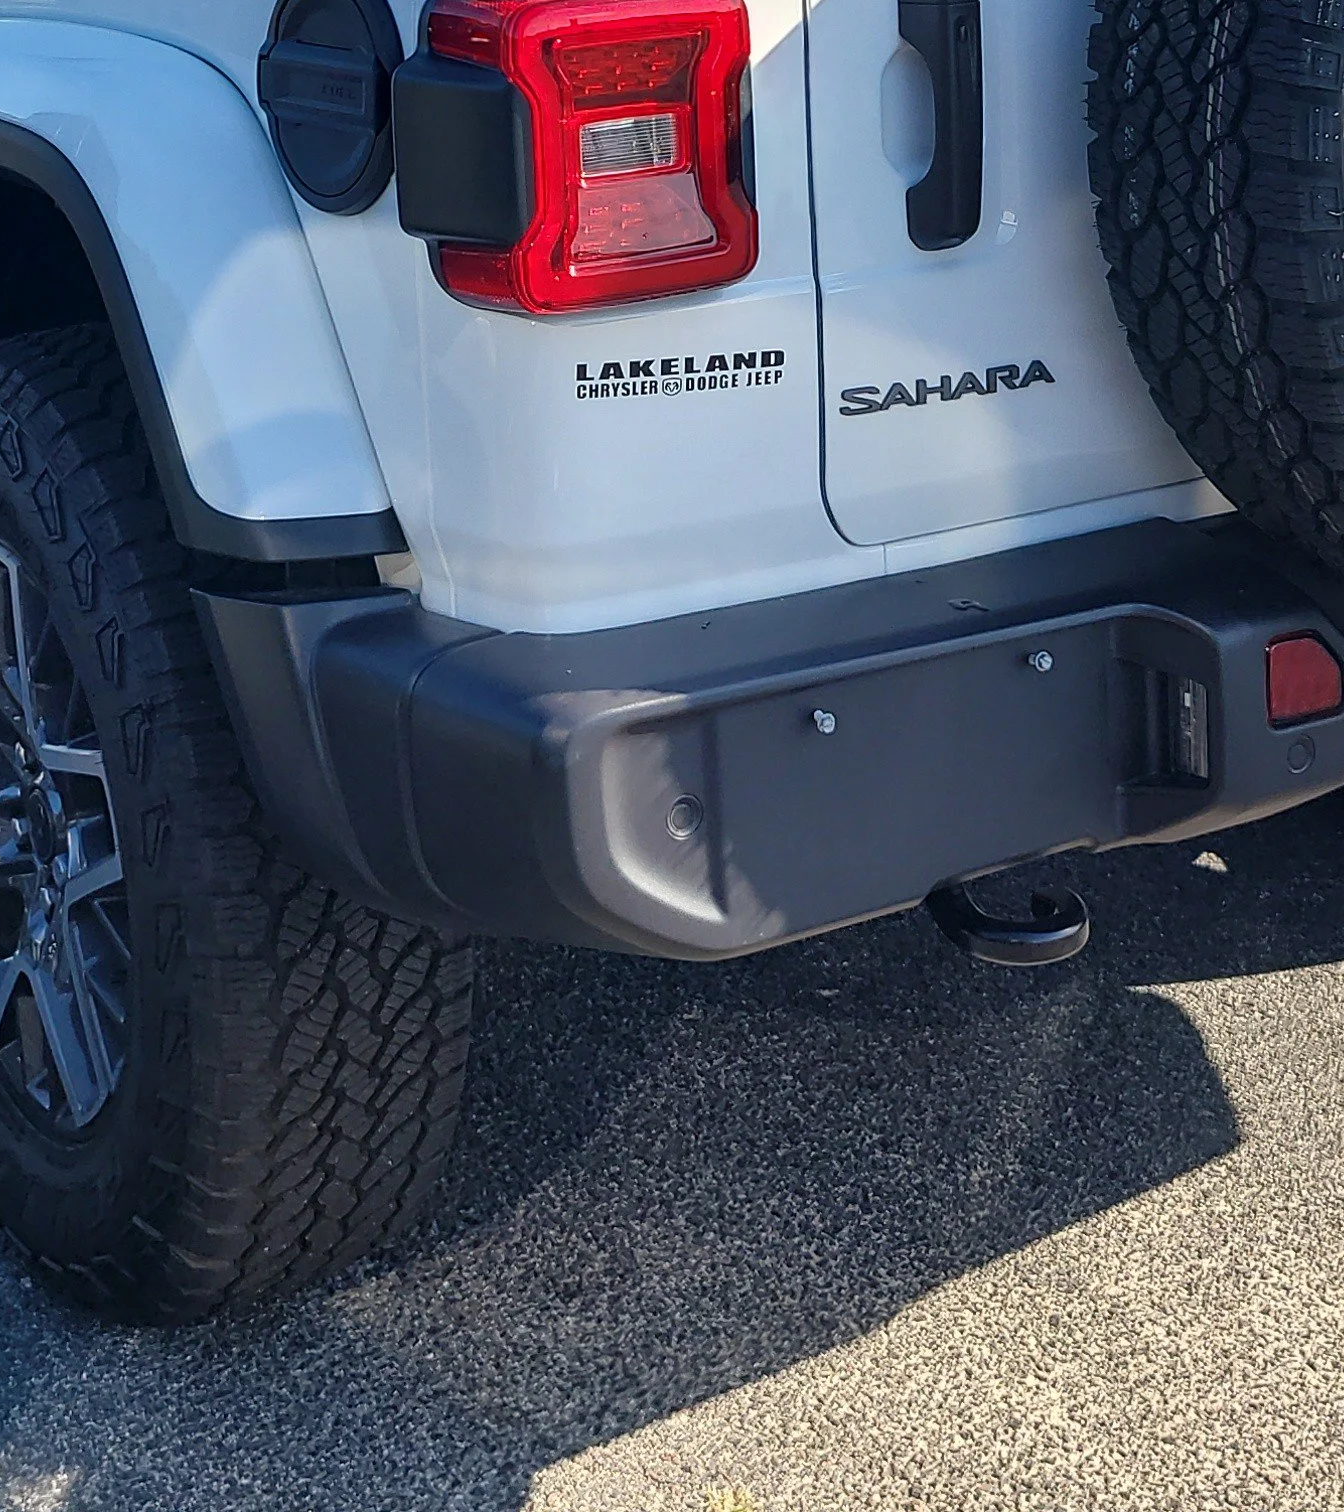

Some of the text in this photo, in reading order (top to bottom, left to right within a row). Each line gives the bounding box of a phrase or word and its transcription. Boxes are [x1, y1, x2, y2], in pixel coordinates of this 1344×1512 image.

[575, 349, 785, 382] LAKELAND
[575, 370, 784, 400] CHRYSLER DODGE JEEP
[839, 359, 1055, 416] SAHARA
